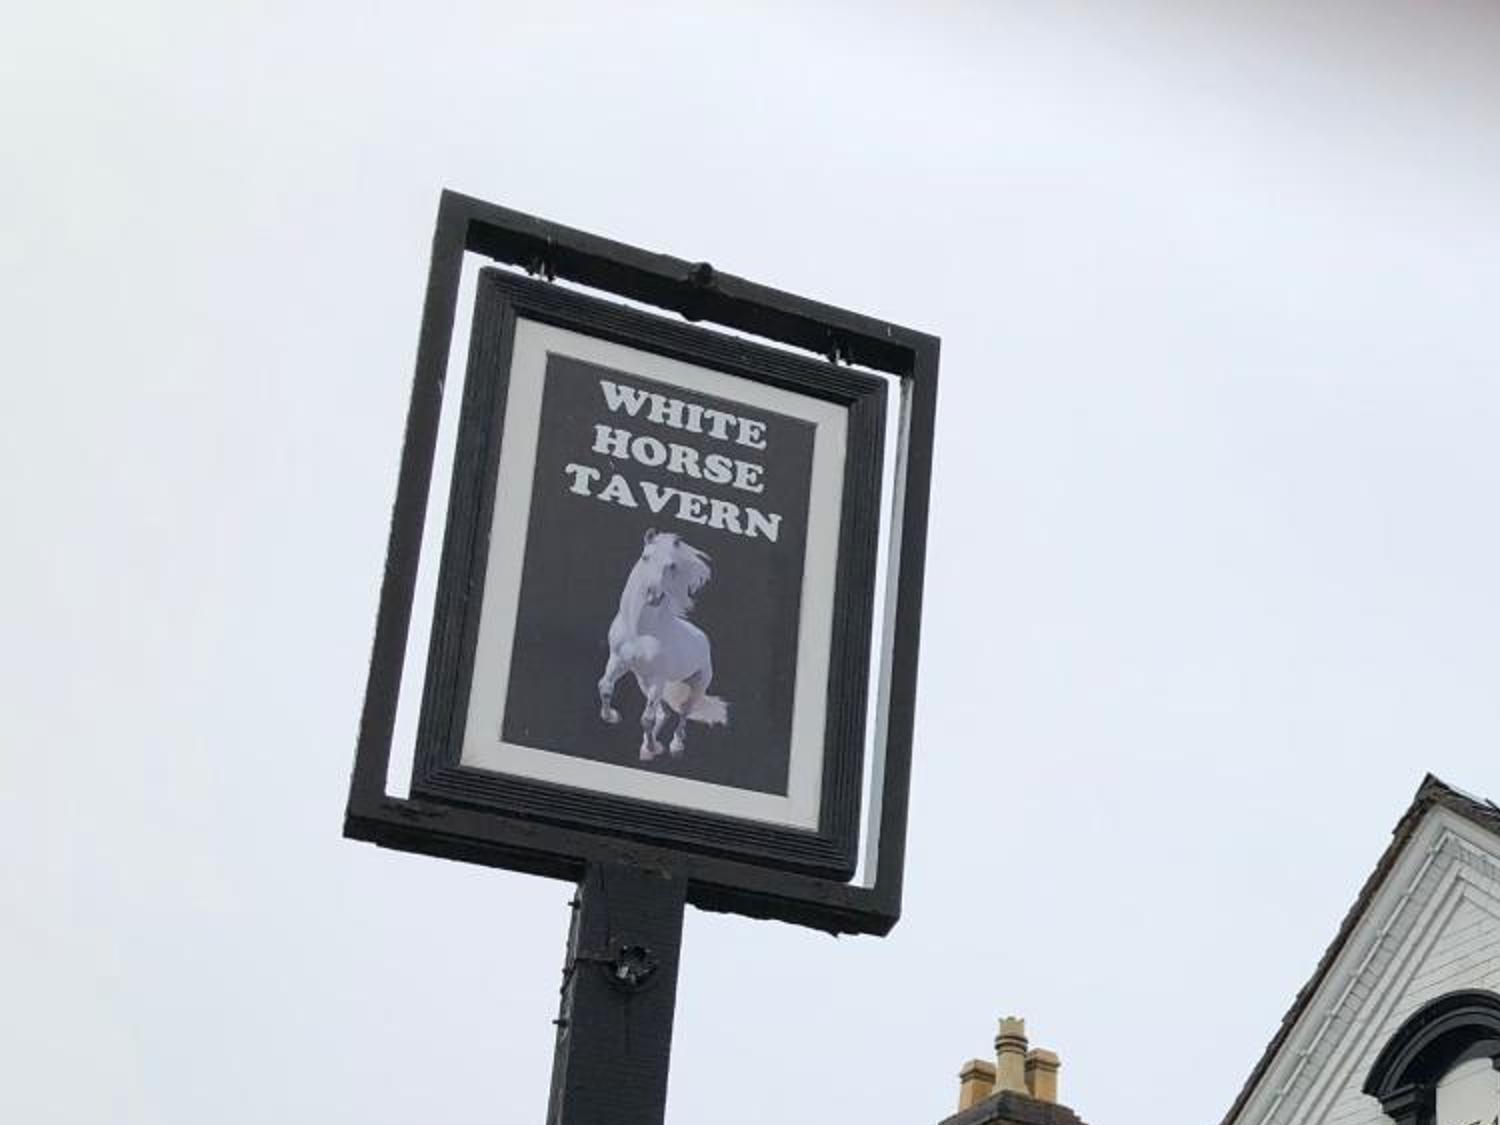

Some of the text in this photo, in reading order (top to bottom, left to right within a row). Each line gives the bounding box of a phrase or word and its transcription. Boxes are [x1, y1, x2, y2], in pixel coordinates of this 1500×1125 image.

[599, 380, 768, 450] WHITE
[591, 424, 766, 494] HORSE
[565, 463, 783, 543] TAVERN
